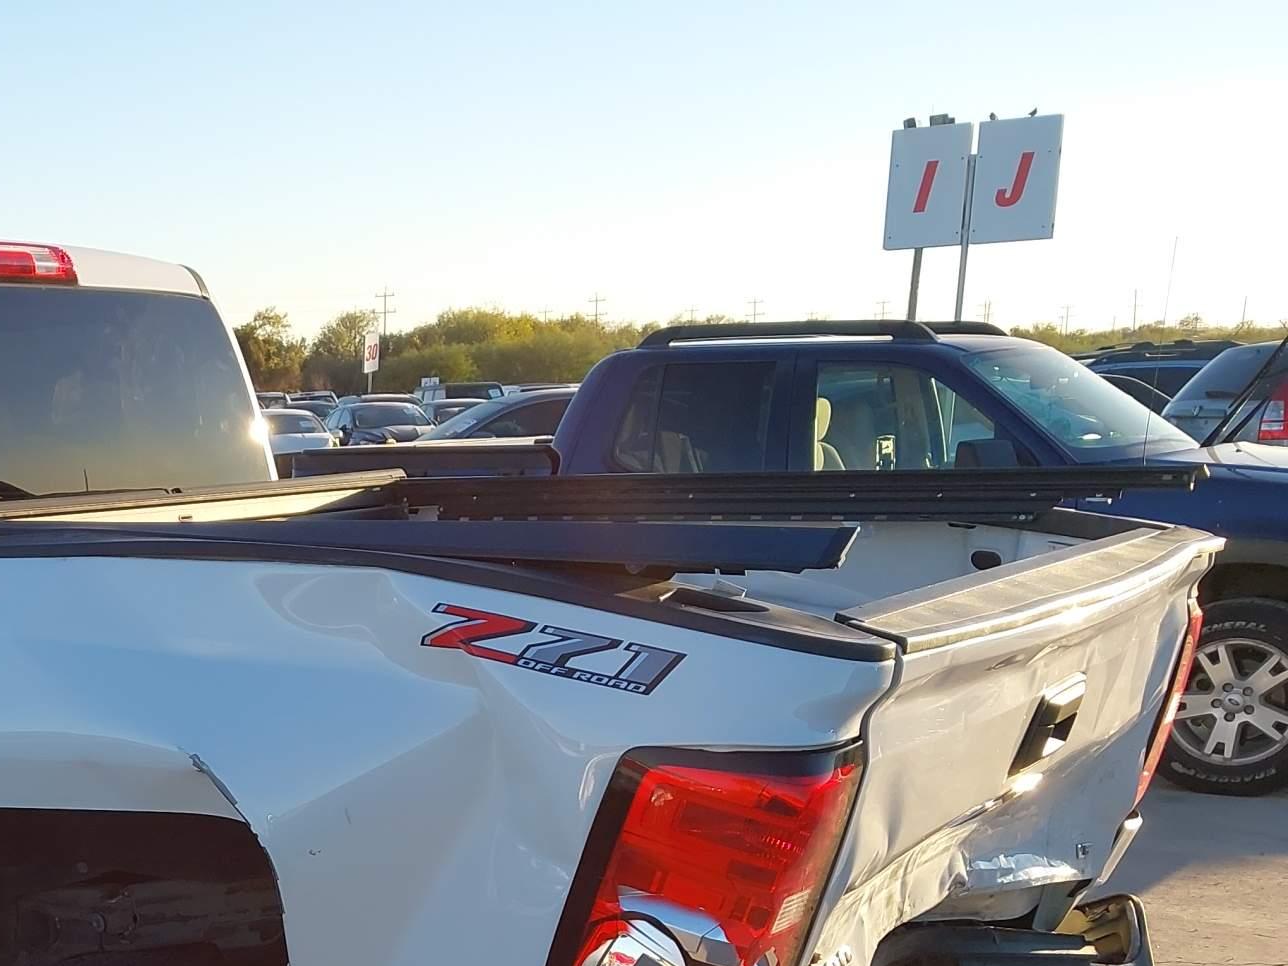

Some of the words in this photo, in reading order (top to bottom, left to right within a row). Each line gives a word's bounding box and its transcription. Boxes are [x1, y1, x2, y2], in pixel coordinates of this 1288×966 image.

[913, 160, 939, 213] I
[995, 152, 1035, 207] J
[366, 343, 378, 361] 30
[421, 603, 687, 691] Z71
[517, 657, 569, 676] OFF
[575, 671, 647, 693] ROAD
